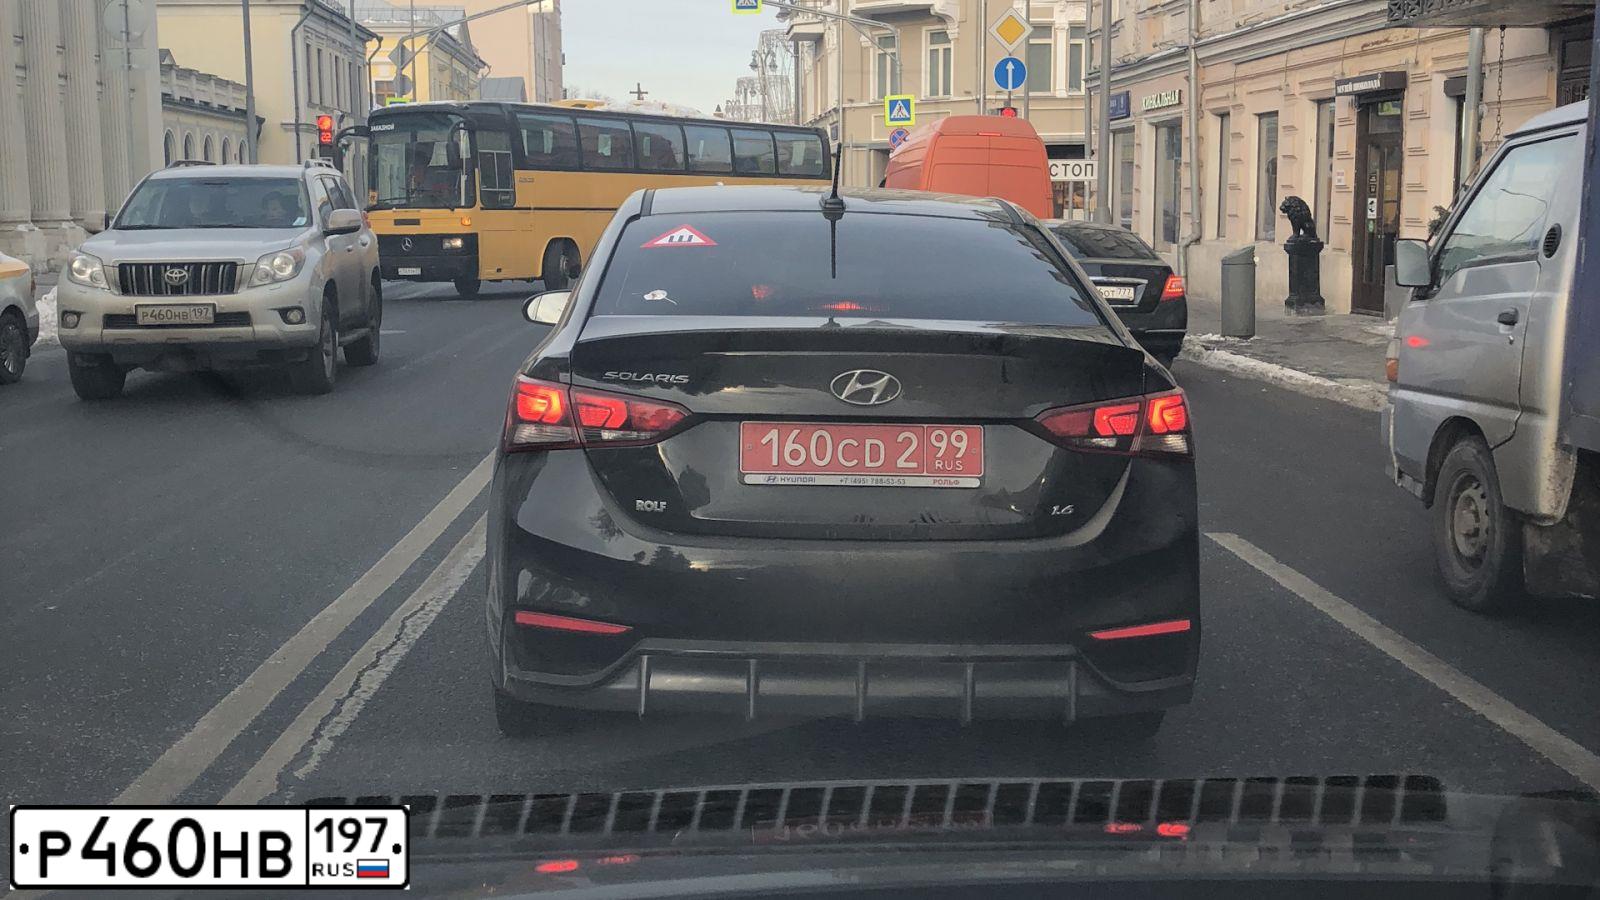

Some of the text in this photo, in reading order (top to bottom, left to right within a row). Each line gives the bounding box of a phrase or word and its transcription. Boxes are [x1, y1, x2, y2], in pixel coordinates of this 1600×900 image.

[1050, 163, 1094, 177] СТОП
[191, 307, 209, 317] 197
[602, 371, 690, 384] SOLARIS
[930, 429, 968, 459] 99
[935, 460, 964, 471] RUS
[780, 476, 816, 484] HYUNDAI
[635, 499, 667, 512] ROLF
